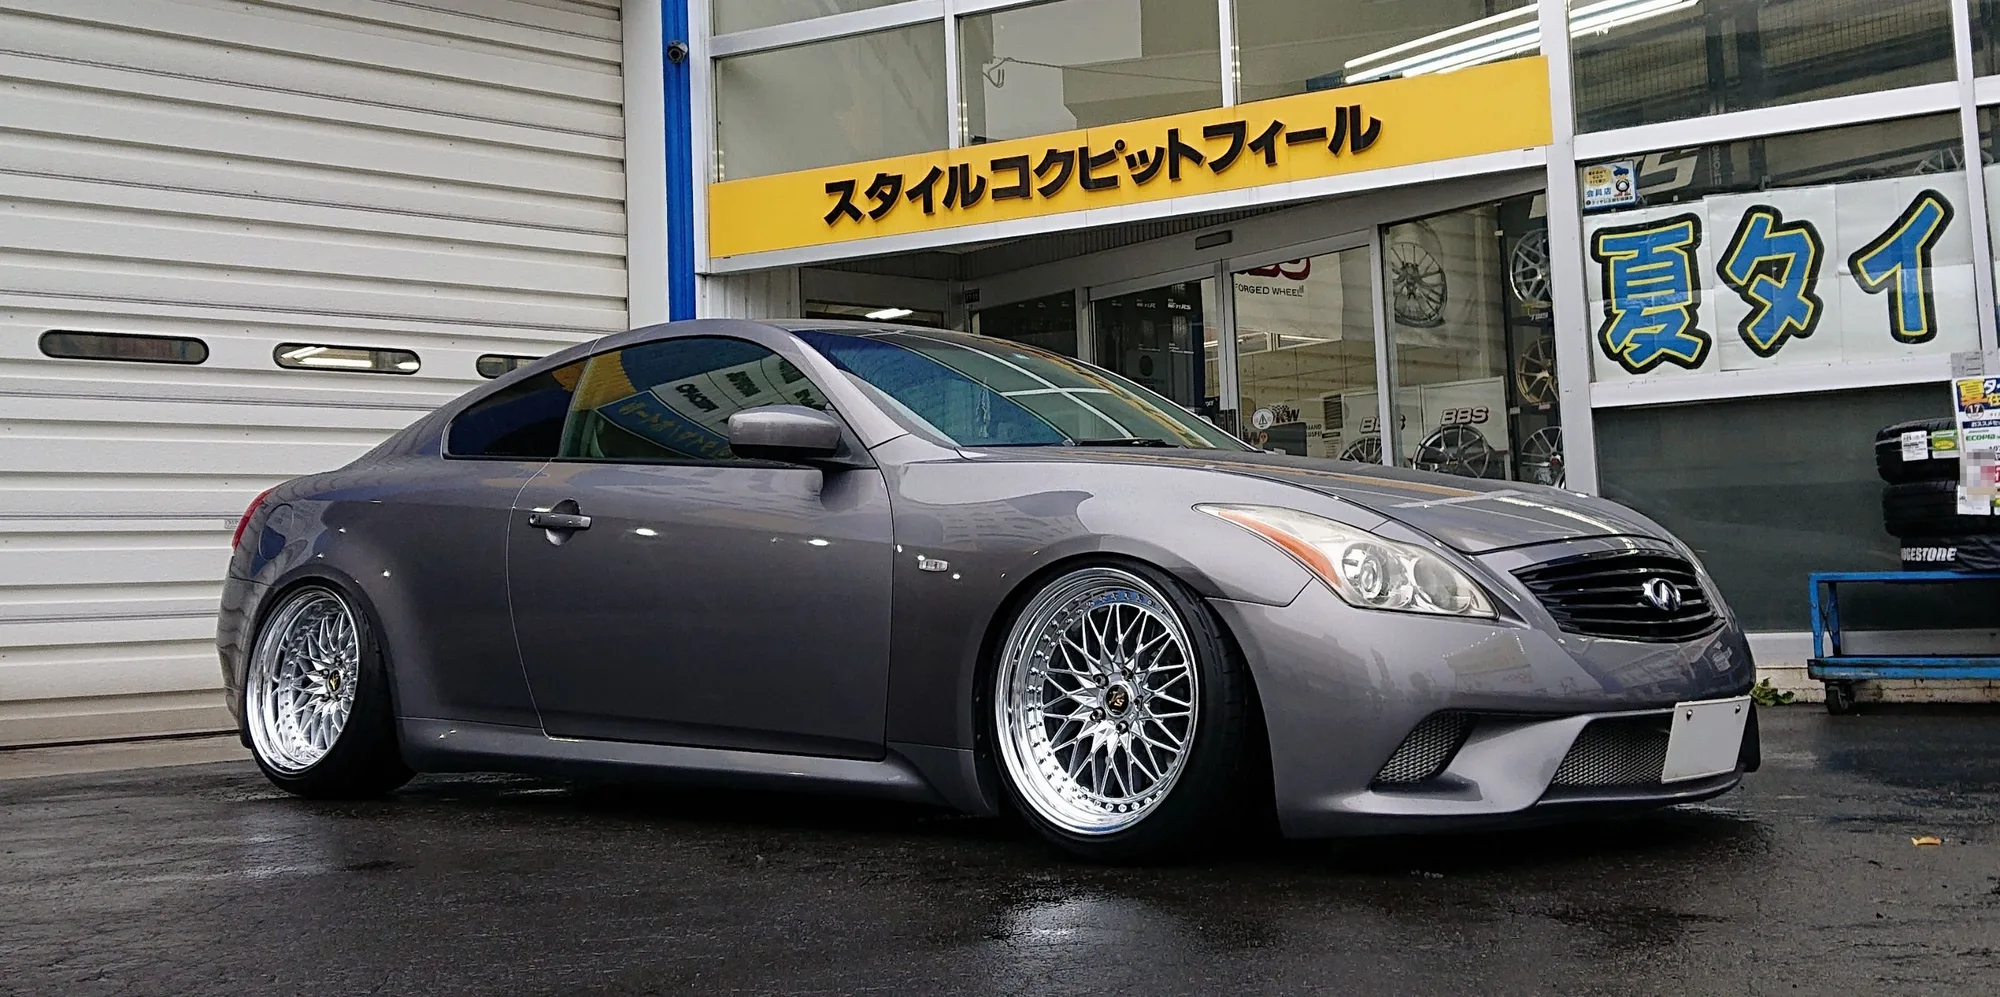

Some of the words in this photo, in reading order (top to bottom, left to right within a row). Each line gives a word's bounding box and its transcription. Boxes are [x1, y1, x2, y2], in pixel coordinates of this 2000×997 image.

[823, 104, 1382, 226] スタイルコクピットフィール
[1440, 406, 1489, 426] BBS
